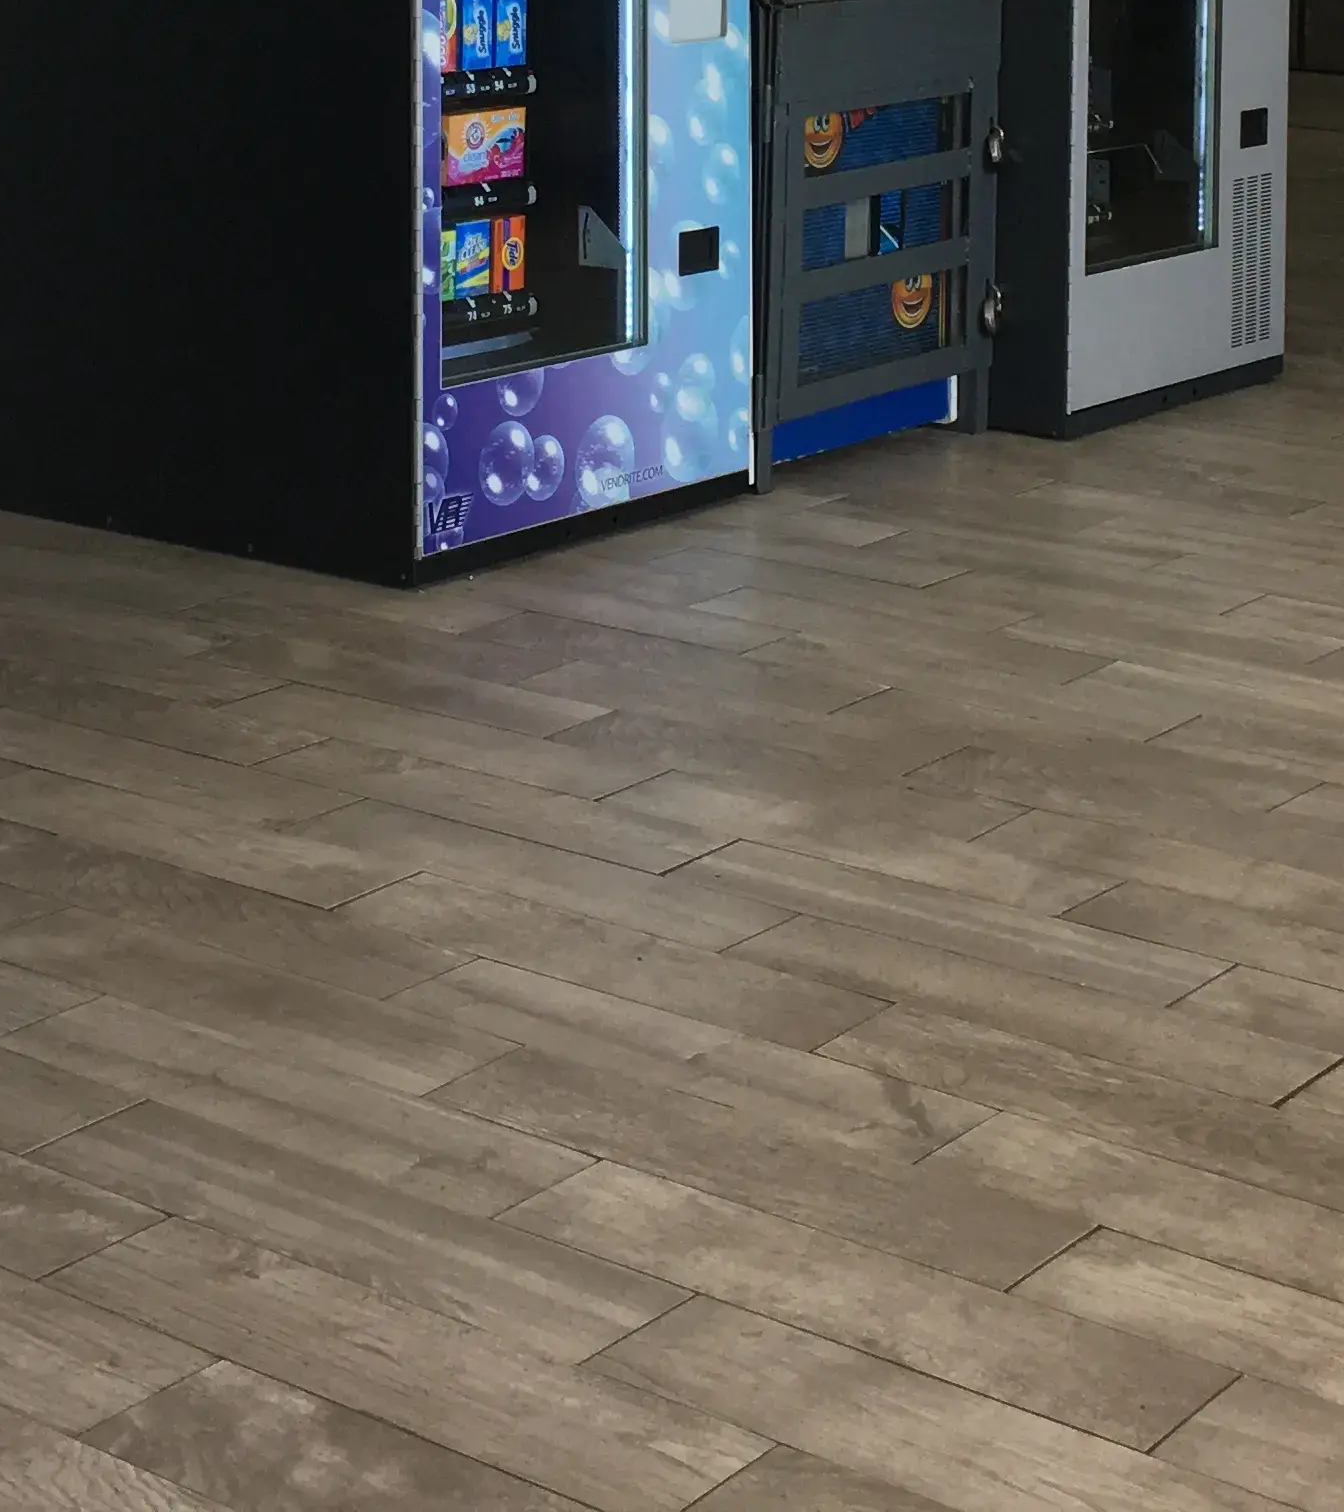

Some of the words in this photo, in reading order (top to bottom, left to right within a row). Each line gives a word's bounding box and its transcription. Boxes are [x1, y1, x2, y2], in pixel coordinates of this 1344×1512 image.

[477, 9, 489, 55] Snuggle
[510, 6, 522, 50] Snuggle
[506, 239, 519, 267] Tide
[600, 464, 665, 492] VENDRITE.COM
